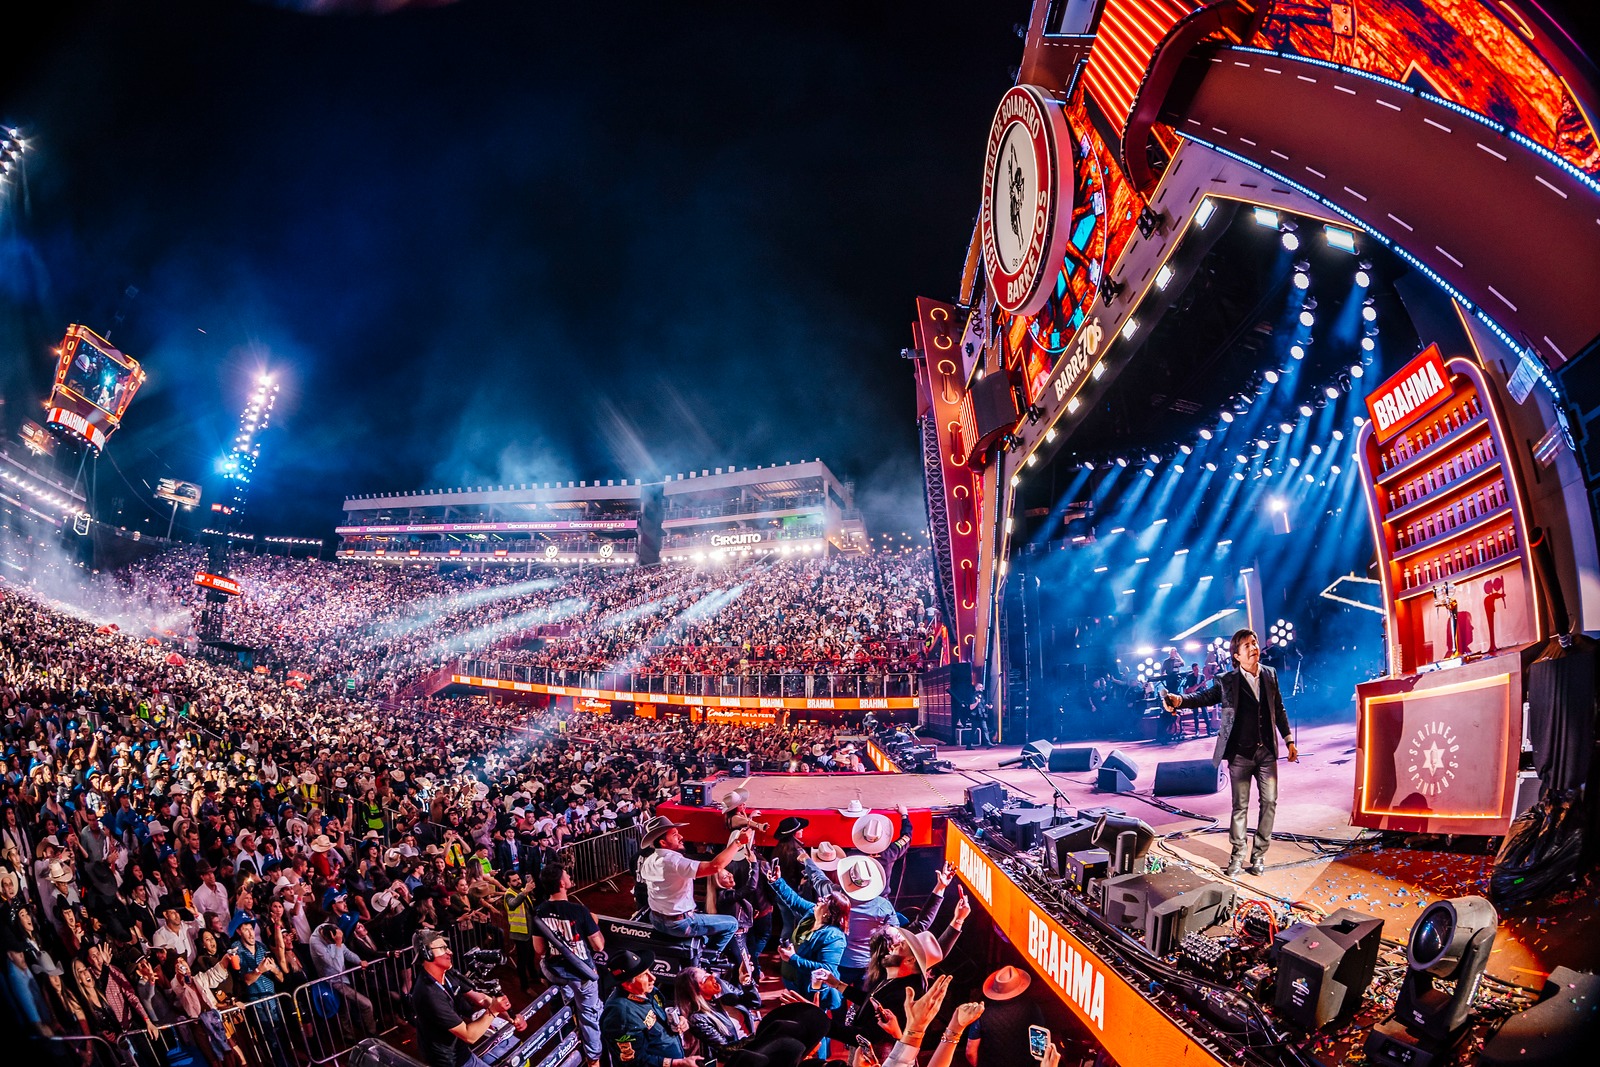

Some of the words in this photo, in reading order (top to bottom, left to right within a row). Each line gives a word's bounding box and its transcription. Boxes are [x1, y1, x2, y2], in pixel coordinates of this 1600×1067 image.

[984, 195, 991, 222] DO
[994, 114, 1004, 141] DE
[1001, 94, 1040, 139] BOIADEIRO
[1007, 190, 1047, 303] BARRETOS
[1373, 361, 1444, 431] BRAHMA
[58, 408, 89, 436] BRAHMA
[711, 533, 761, 546] CIRCUITO
[759, 698, 784, 708] BRAHMA
[807, 698, 835, 709] BRAHMA
[859, 699, 888, 709] BRAHMA
[1408, 721, 1460, 756] SERTANEJO
[960, 839, 992, 907] BRAHMA
[1028, 909, 1105, 1031] BRAHMA
